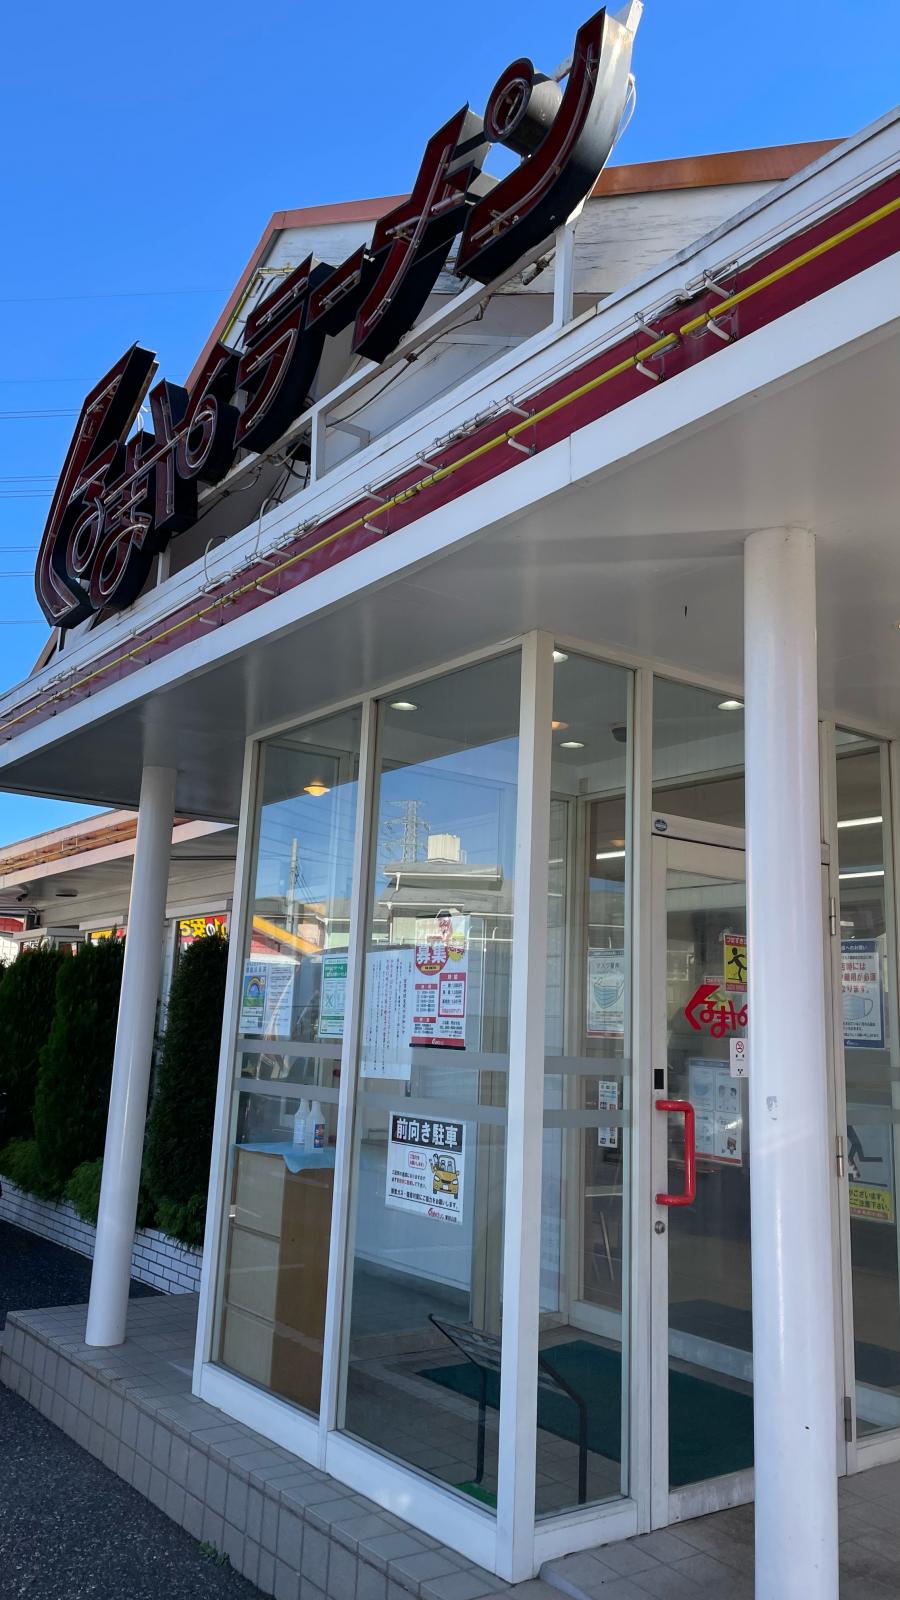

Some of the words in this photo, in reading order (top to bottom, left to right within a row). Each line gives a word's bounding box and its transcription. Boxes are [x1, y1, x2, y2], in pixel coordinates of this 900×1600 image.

[35, 5, 636, 627] くるまやラーメン
[726, 936, 747, 945] つまずき
[396, 1117, 459, 1149] 前向き駐車
